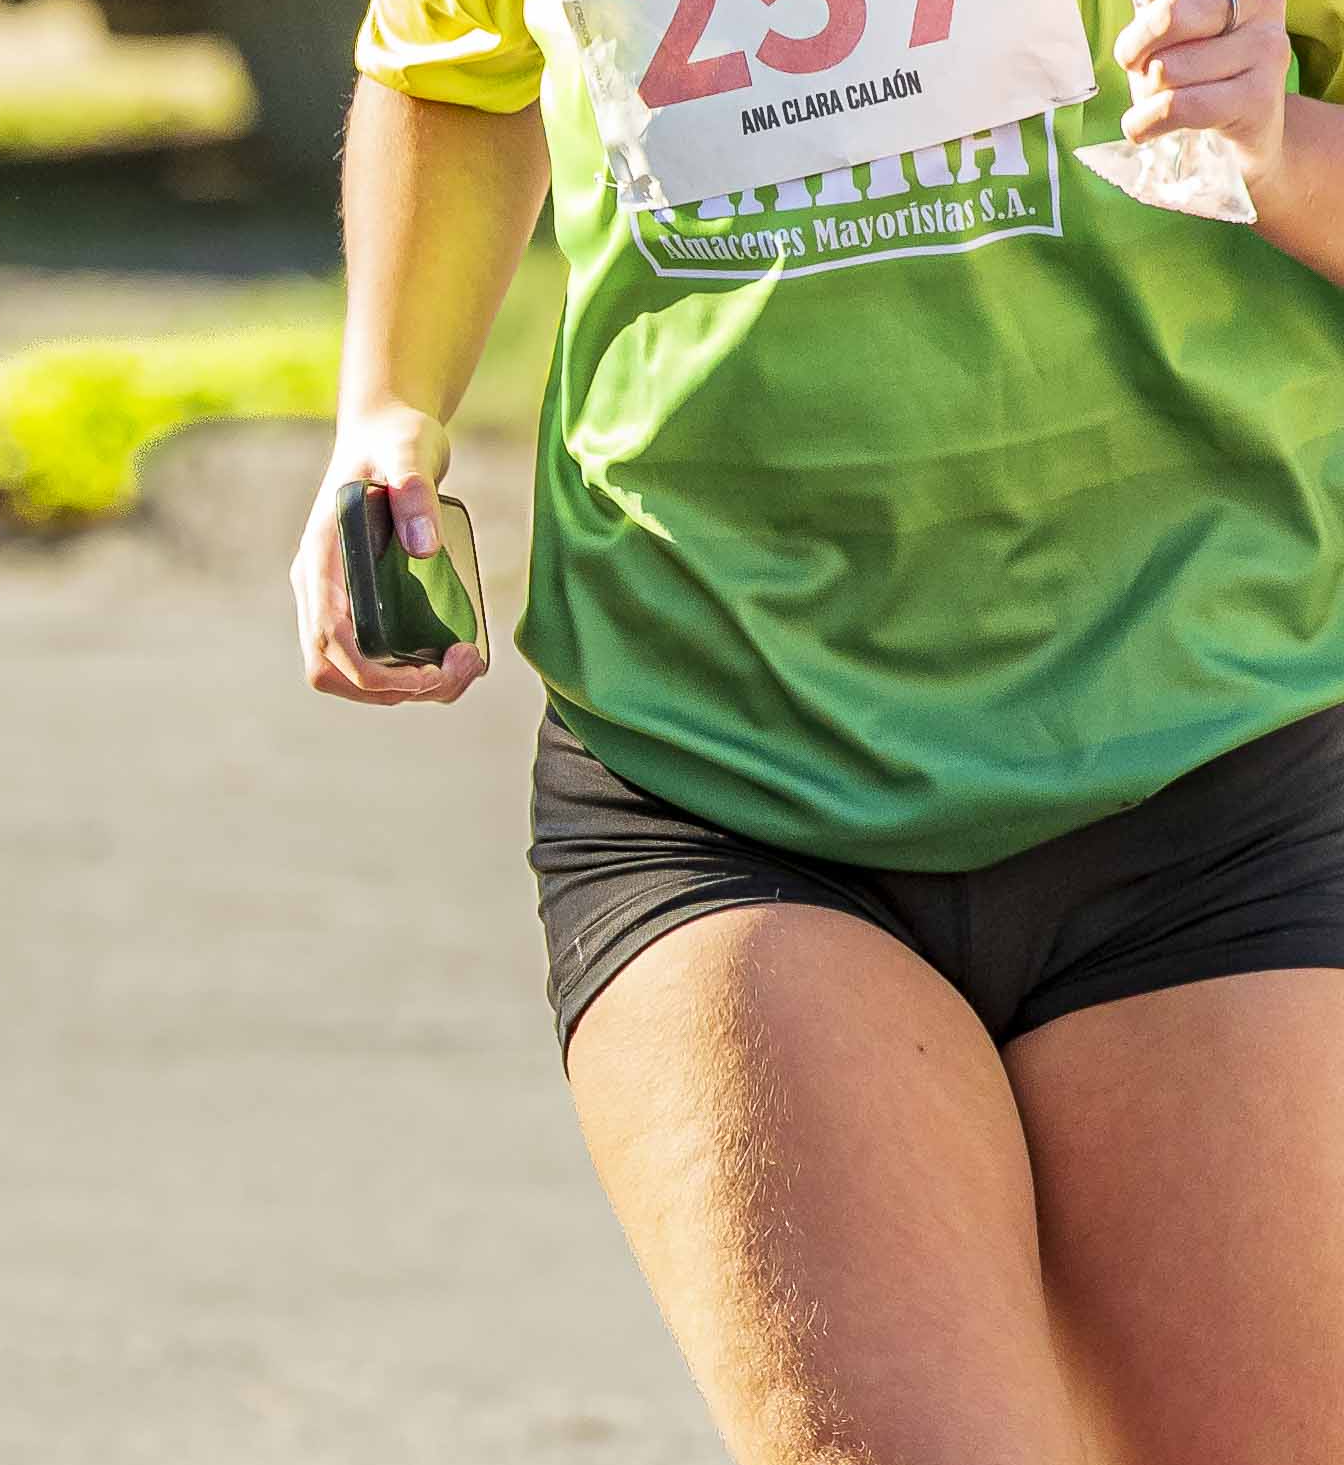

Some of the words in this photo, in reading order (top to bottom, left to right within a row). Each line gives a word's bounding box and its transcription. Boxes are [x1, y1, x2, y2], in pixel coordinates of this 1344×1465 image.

[741, 104, 781, 135] ANA
[782, 89, 844, 124] CLARA
[845, 68, 923, 110] CALAÓN
[659, 224, 806, 261] Almacenes
[813, 198, 976, 254] Mayoristas
[979, 187, 1037, 223] S.A.
